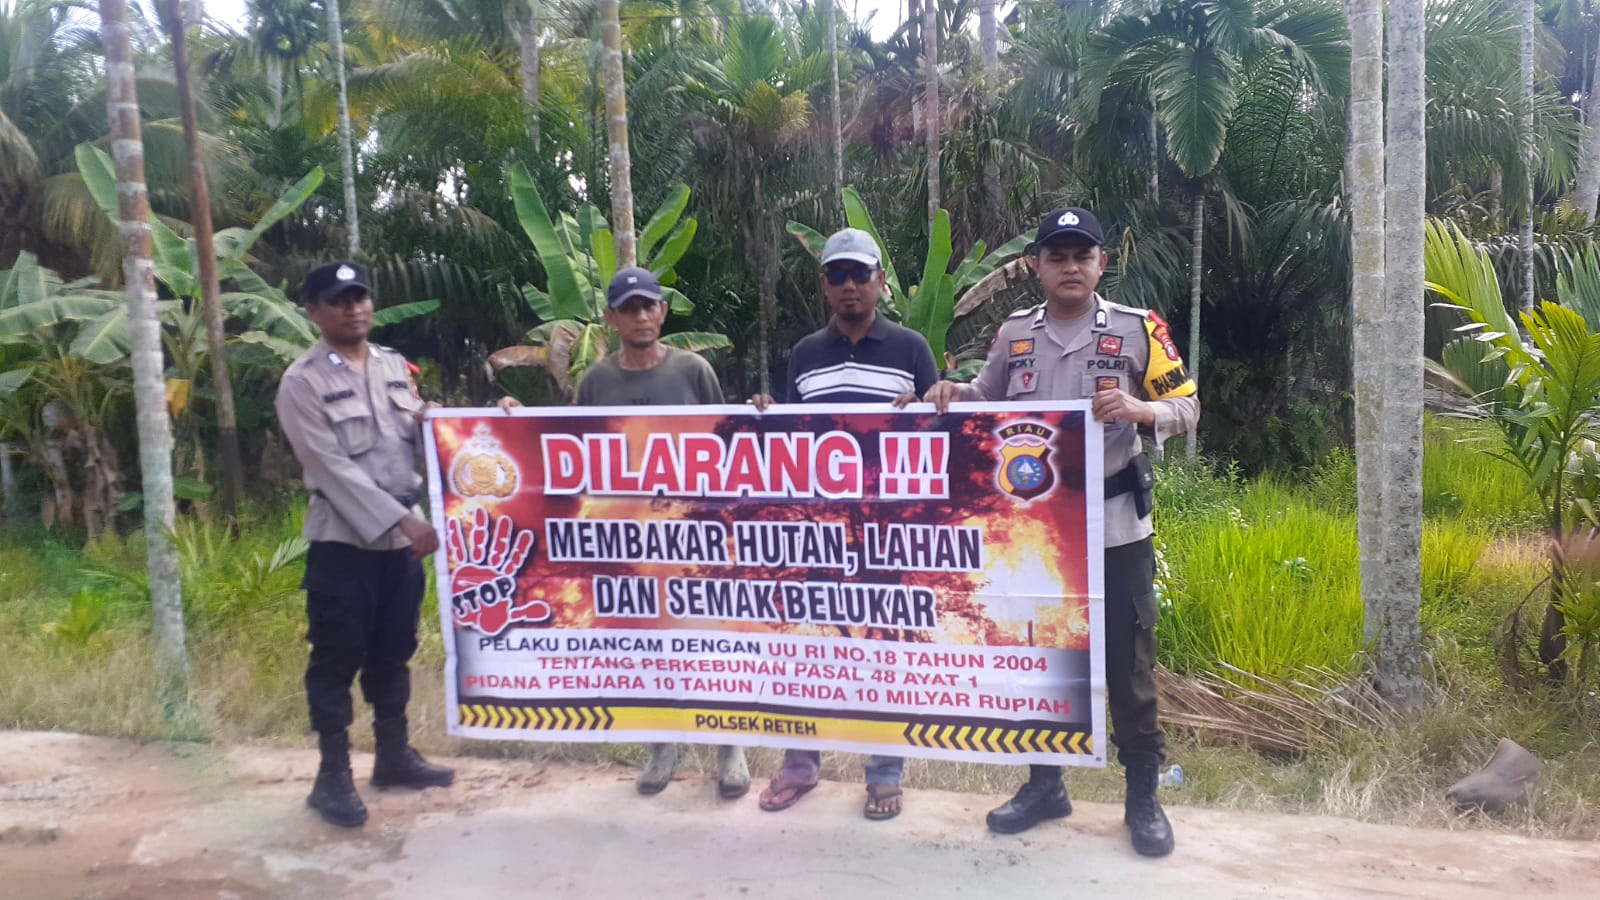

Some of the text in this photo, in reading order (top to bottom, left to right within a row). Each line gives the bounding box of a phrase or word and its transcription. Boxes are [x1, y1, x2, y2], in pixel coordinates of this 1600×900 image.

[1087, 359, 1125, 370] POLRI
[1006, 425, 1045, 436] RIAU
[542, 432, 949, 498] DILARANG !!!
[546, 519, 984, 574] MEMBAKAR HUTAN, LAHAN
[452, 577, 512, 615] STOP
[594, 575, 936, 628] DAN SEMAK BELUKAR
[479, 637, 1048, 672] PELAKU DIANCAM DENGAN UU RI NO.18 TAHUN 2004
[537, 656, 978, 689] TENTANG PERKEBUNAN PASAL 48 AYAT 1
[465, 674, 541, 689] PIDANA
[549, 675, 645, 690] PENJARA
[653, 677, 675, 691] 10
[680, 678, 753, 694] TAHUN
[772, 682, 846, 700] DENDA
[855, 688, 878, 703] 10
[886, 689, 971, 708] MILYAR
[979, 695, 1071, 715] RUPIAH
[695, 714, 817, 735] POLSEK RETEH
